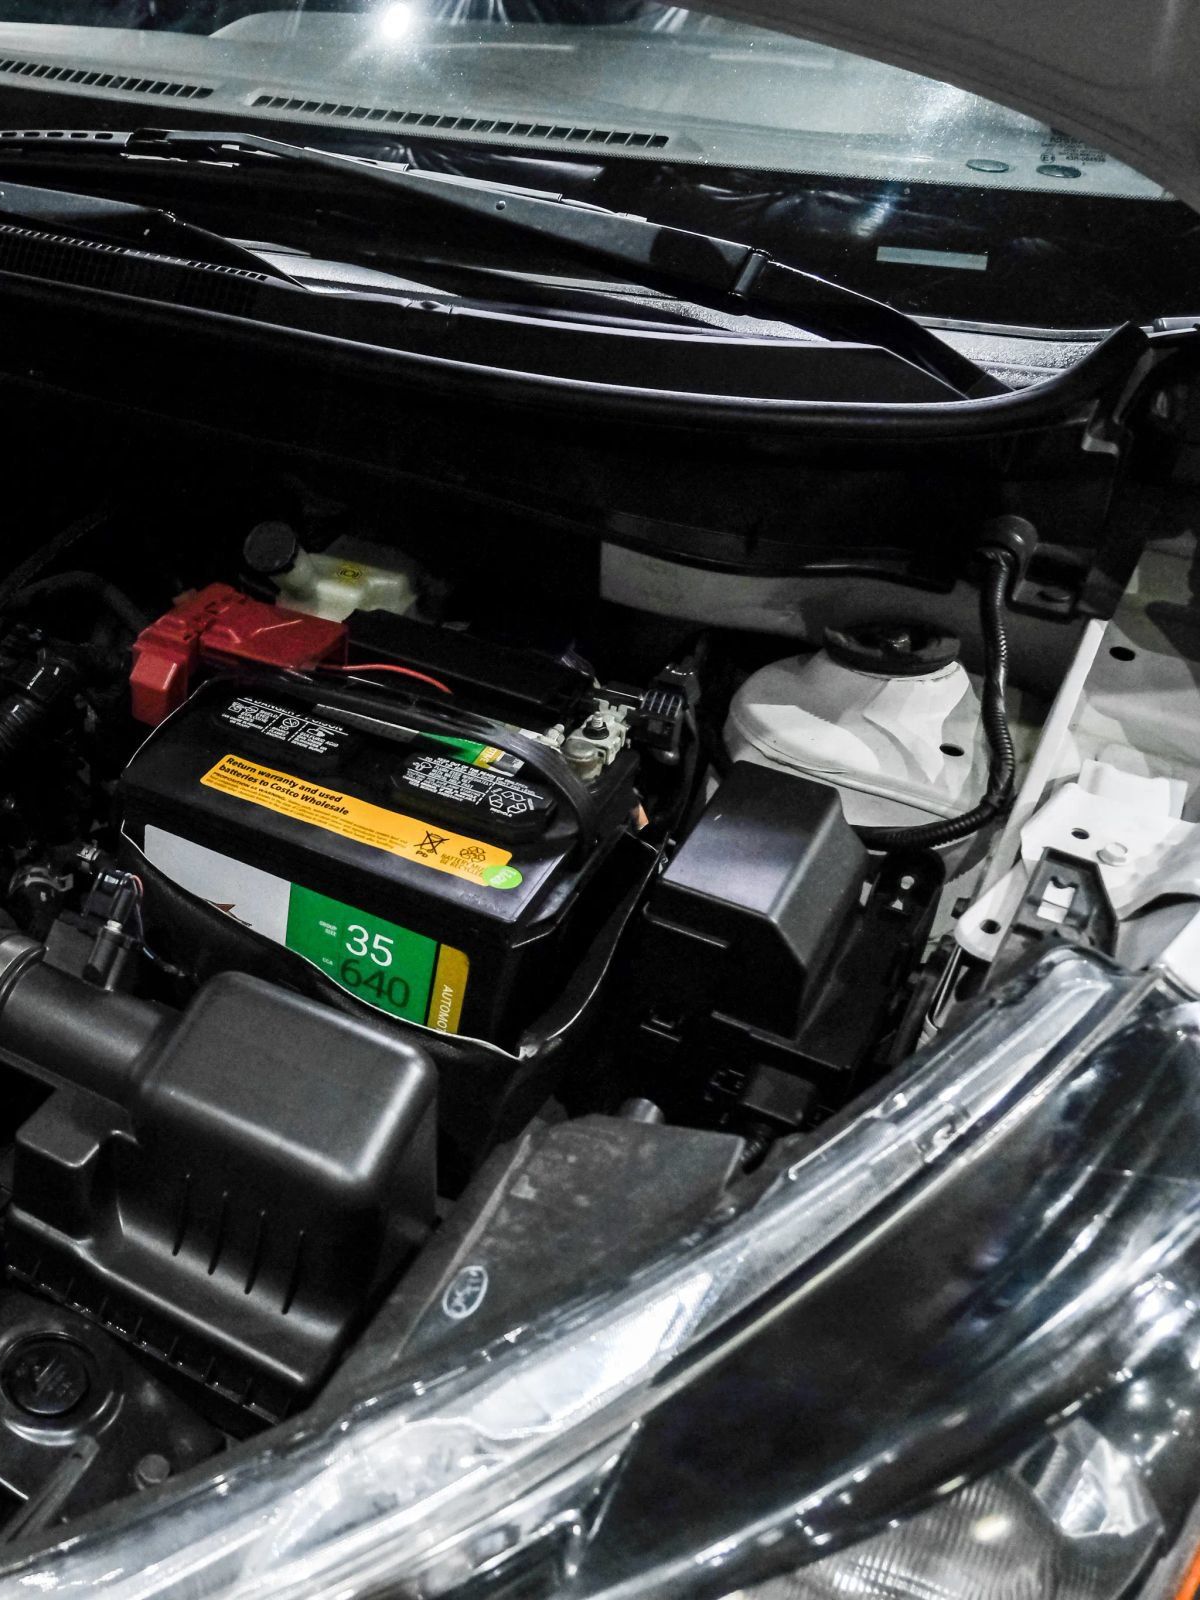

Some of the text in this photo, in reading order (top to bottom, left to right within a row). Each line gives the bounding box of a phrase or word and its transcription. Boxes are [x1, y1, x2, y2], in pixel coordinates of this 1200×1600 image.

[218, 764, 259, 784] batteries
[260, 778, 269, 787] to
[270, 782, 300, 798] Costco
[301, 794, 350, 816] Wholesale
[226, 757, 343, 803] Return warranty and used
[345, 924, 394, 967] 35
[340, 958, 411, 1009] 640
